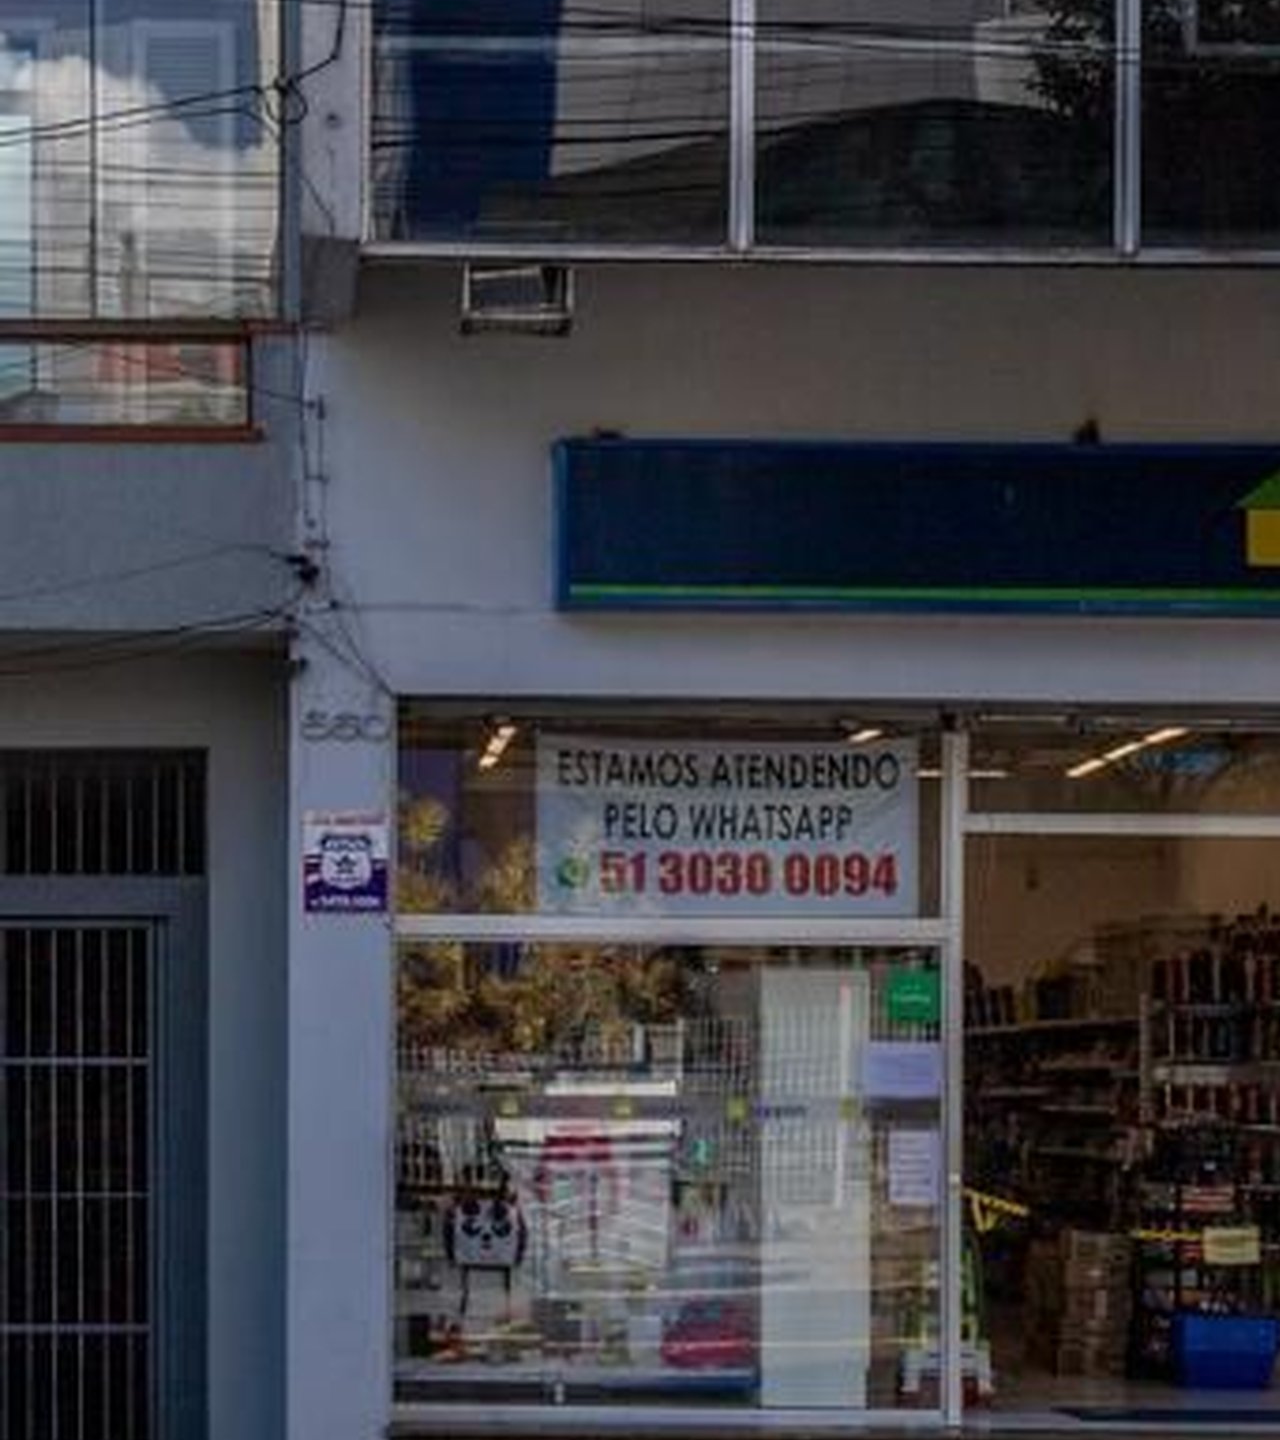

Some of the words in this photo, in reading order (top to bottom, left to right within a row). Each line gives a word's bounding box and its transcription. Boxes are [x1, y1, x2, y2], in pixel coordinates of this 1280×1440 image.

[556, 749, 700, 788] ESTAMOS
[709, 749, 901, 791] ATENDENDO
[602, 802, 678, 841] PELO
[688, 803, 853, 842] WHATSAPP
[599, 850, 648, 895] 51
[657, 851, 770, 896] 3030
[783, 851, 899, 897] 0094
